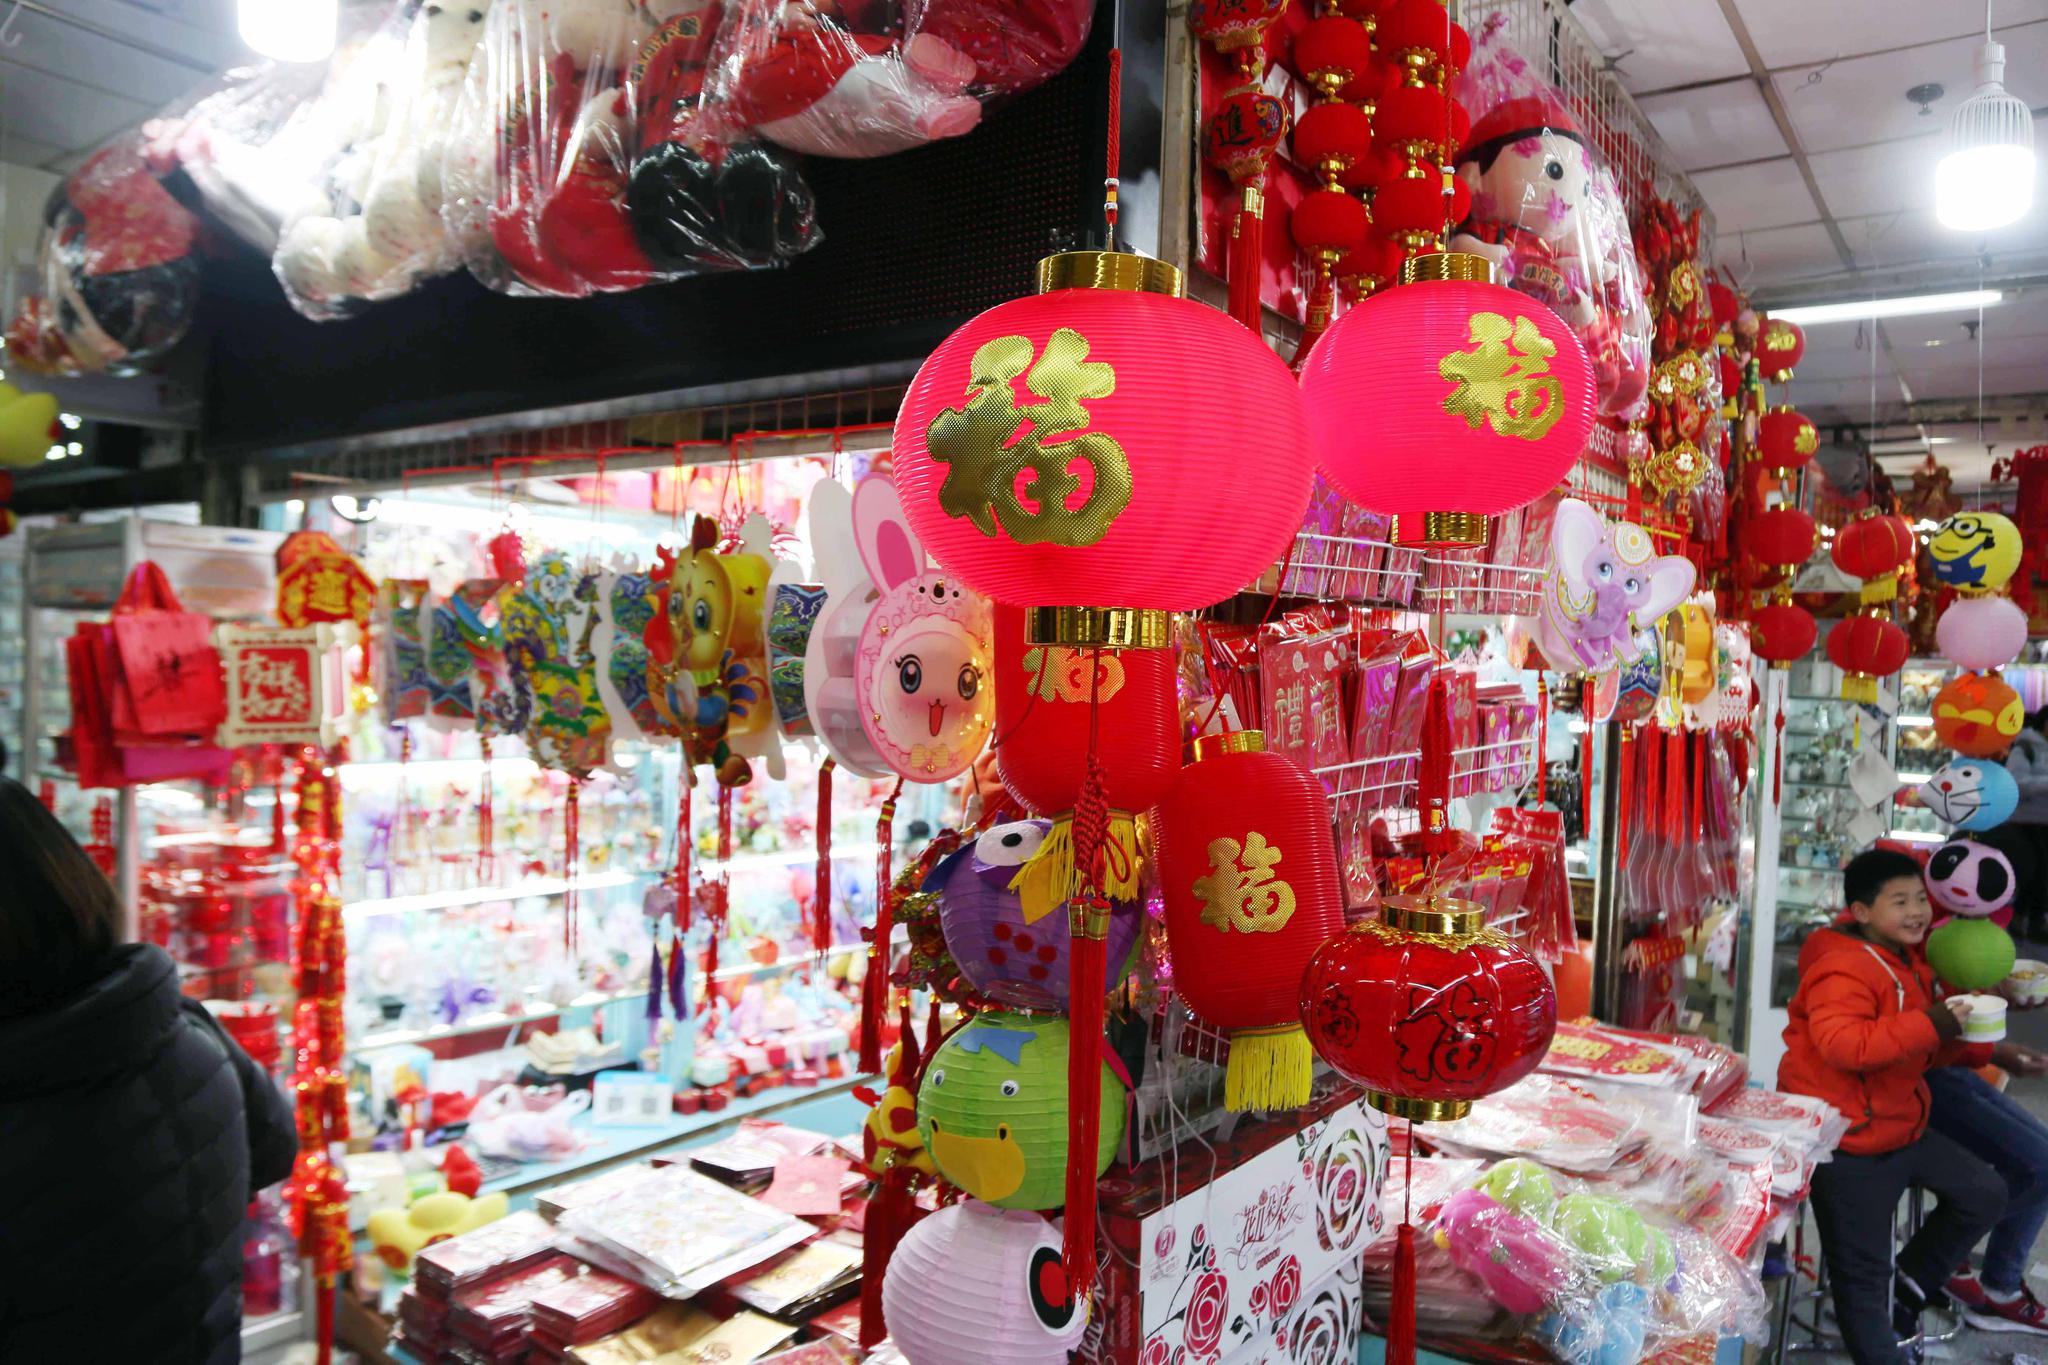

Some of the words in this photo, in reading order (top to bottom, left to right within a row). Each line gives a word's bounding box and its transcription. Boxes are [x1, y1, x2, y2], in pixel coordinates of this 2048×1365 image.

[926, 328, 1133, 548] 福
[1439, 312, 1565, 441] 福
[1192, 832, 1297, 934] 福
